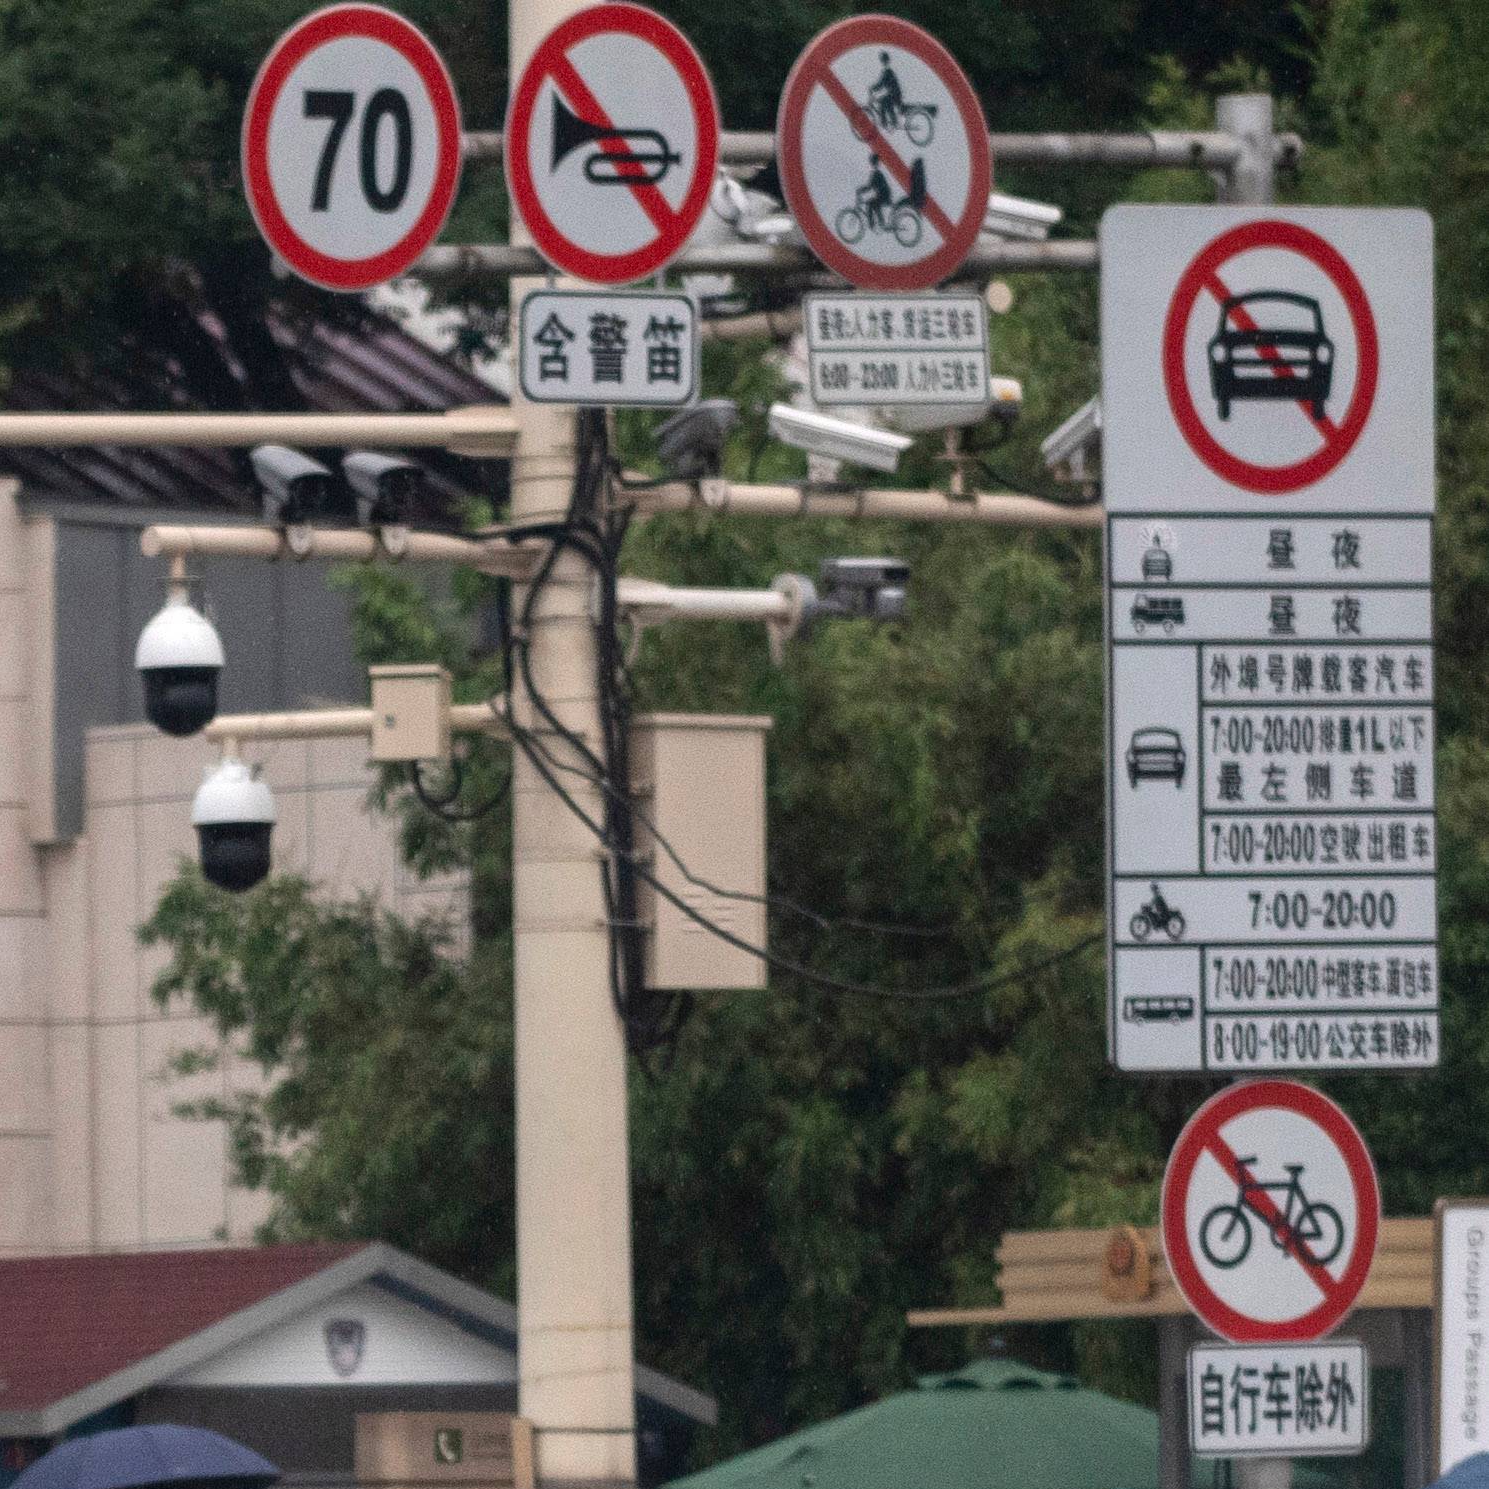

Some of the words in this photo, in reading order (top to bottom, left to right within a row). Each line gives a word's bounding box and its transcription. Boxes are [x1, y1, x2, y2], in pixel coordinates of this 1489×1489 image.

[303, 88, 413, 214] 70
[533, 310, 685, 385] 含警笛
[1267, 529, 1361, 570] 昼夜
[1268, 595, 1362, 636] 昼夜
[1210, 654, 1424, 694] 外埠号牌载客汽车
[1218, 762, 1418, 803] 最左侧车道
[1248, 890, 1397, 930] 7:00-20:00
[1201, 1361, 1356, 1436] 自行车除外
[1461, 1330, 1485, 1441] Passage
